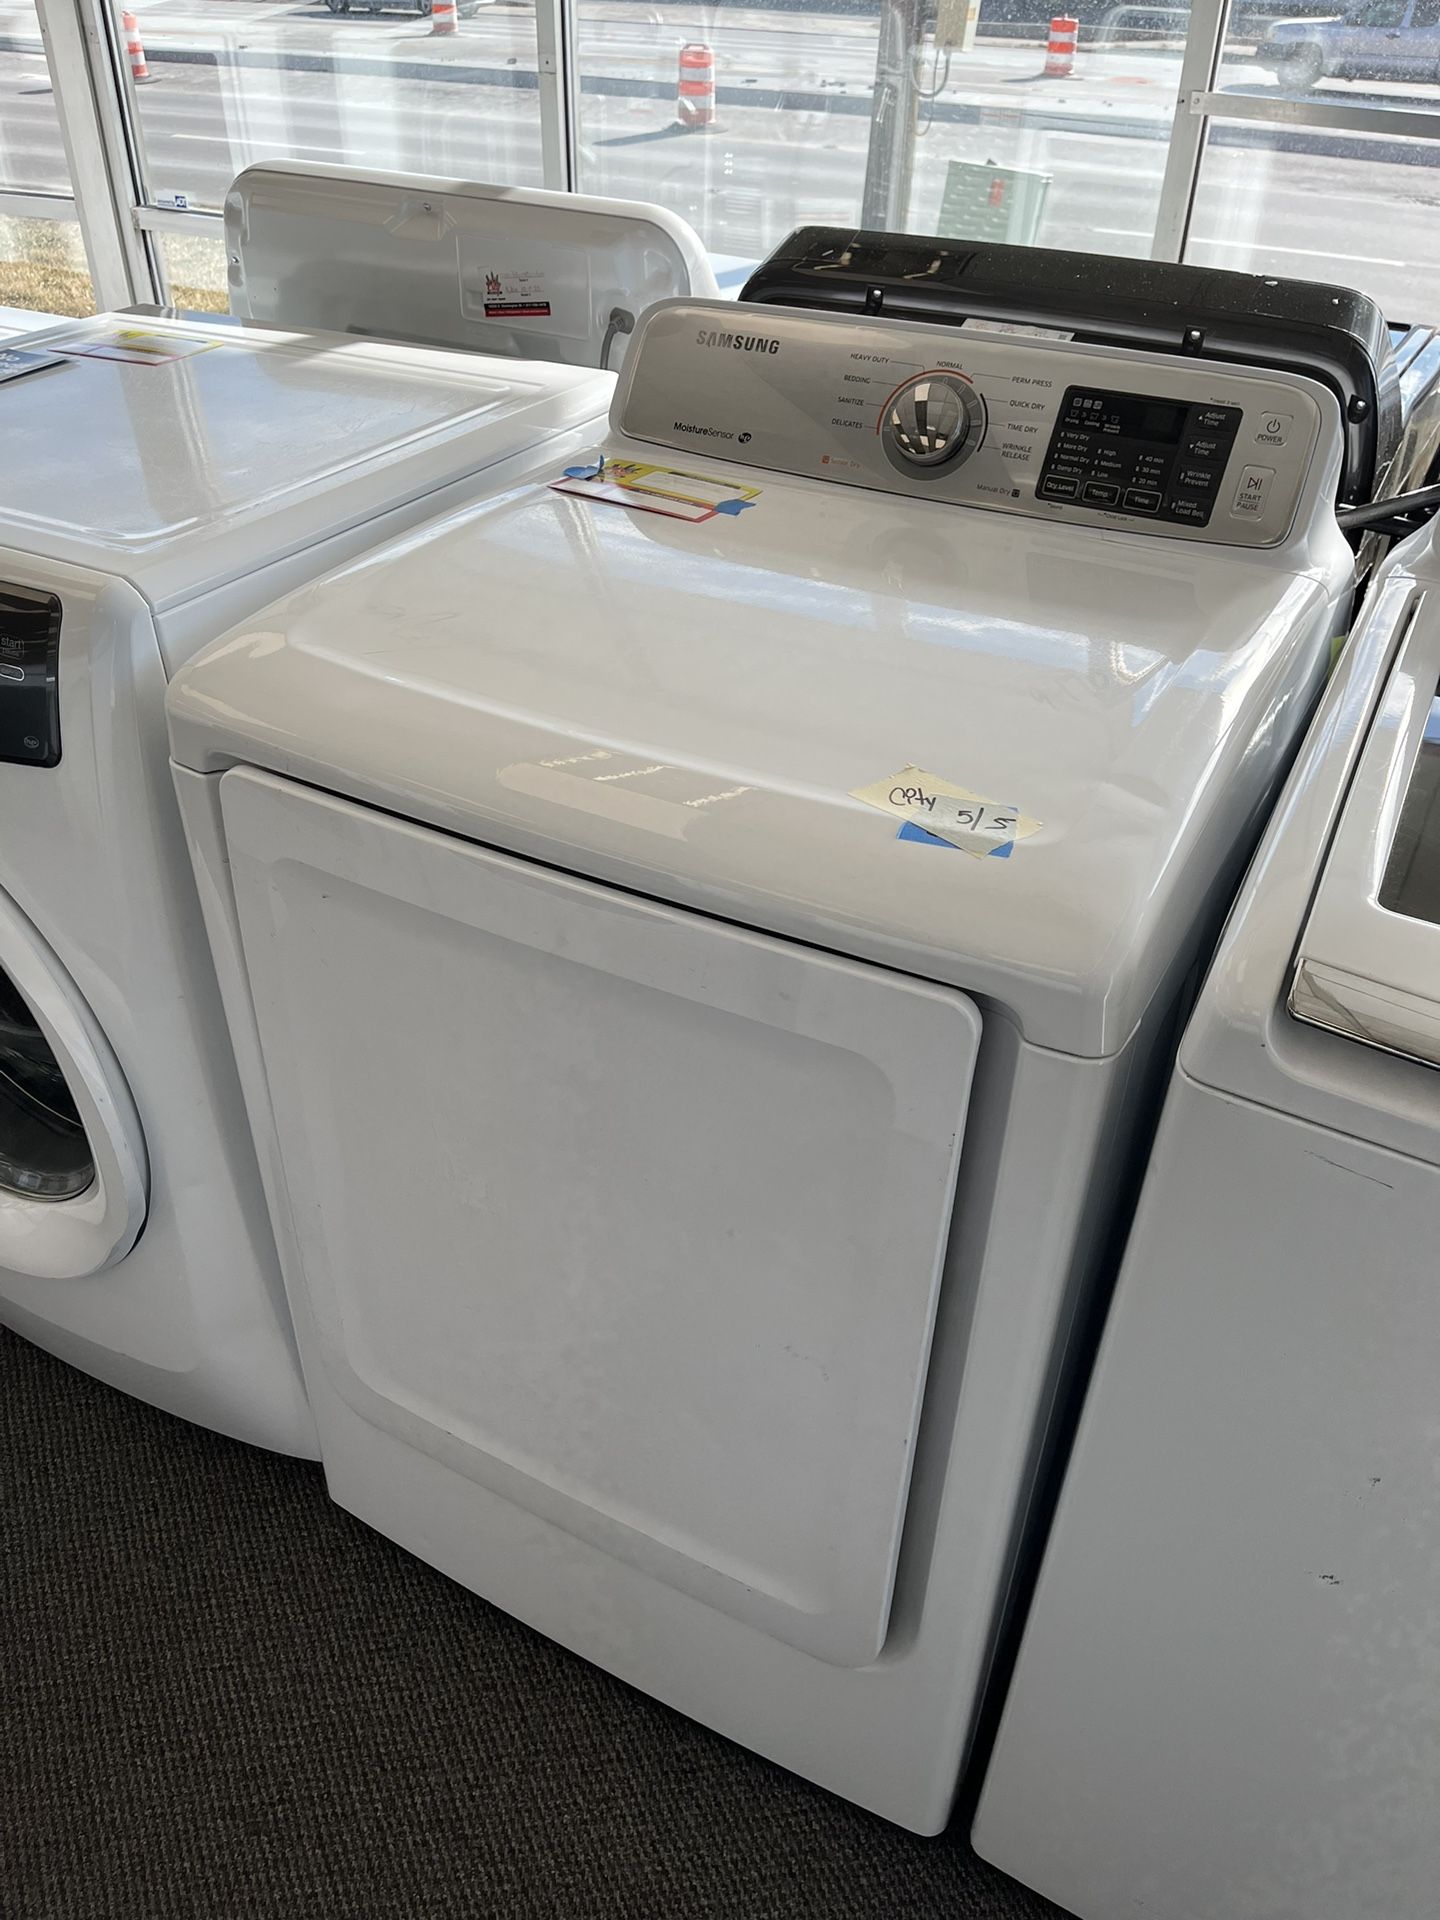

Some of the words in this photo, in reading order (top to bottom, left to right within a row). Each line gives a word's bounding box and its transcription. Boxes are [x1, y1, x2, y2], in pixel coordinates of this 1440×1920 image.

[696, 330, 780, 355] SAMSUNG
[850, 353, 871, 363] HEAVY
[872, 355, 889, 364] DUTY
[936, 360, 963, 370] NORMAL
[844, 374, 871, 384] BEDDING
[1011, 376, 1030, 386] PERM
[1031, 378, 1052, 388] PRESS
[838, 396, 864, 406] SANITIZE
[1009, 400, 1030, 410] QUICK
[1032, 402, 1046, 411] DRY
[1204, 411, 1226, 420] Adjust
[832, 418, 863, 429] DELICATES
[673, 422, 734, 440] MoistureSensor
[1007, 424, 1022, 432] TIME
[1024, 426, 1039, 434] DRY
[1066, 432, 1079, 440] Very
[1257, 433, 1283, 444] POWER
[1002, 442, 1032, 453] WRINKLE
[1063, 442, 1077, 450] More
[1077, 444, 1088, 452] Dry
[1195, 440, 1217, 450] Adjust
[1001, 451, 1030, 461] RELEASE
[1194, 448, 1210, 456] Time
[1060, 454, 1080, 462] Normal
[1080, 456, 1090, 464] Dry
[1100, 460, 1122, 468] Medium
[1186, 470, 1212, 480] Wrinkle
[1046, 482, 1058, 490] Dry
[1058, 484, 1075, 492] Level
[1184, 478, 1209, 487] Prevent
[976, 484, 998, 494] Manual
[998, 487, 1011, 497] Dry
[1134, 496, 1150, 504] Time
[1239, 492, 1262, 502] START
[1177, 500, 1198, 508] Mixed
[1236, 500, 1259, 512] PAUSE
[1176, 507, 1191, 516] Load
[0, 636, 22, 650] start
